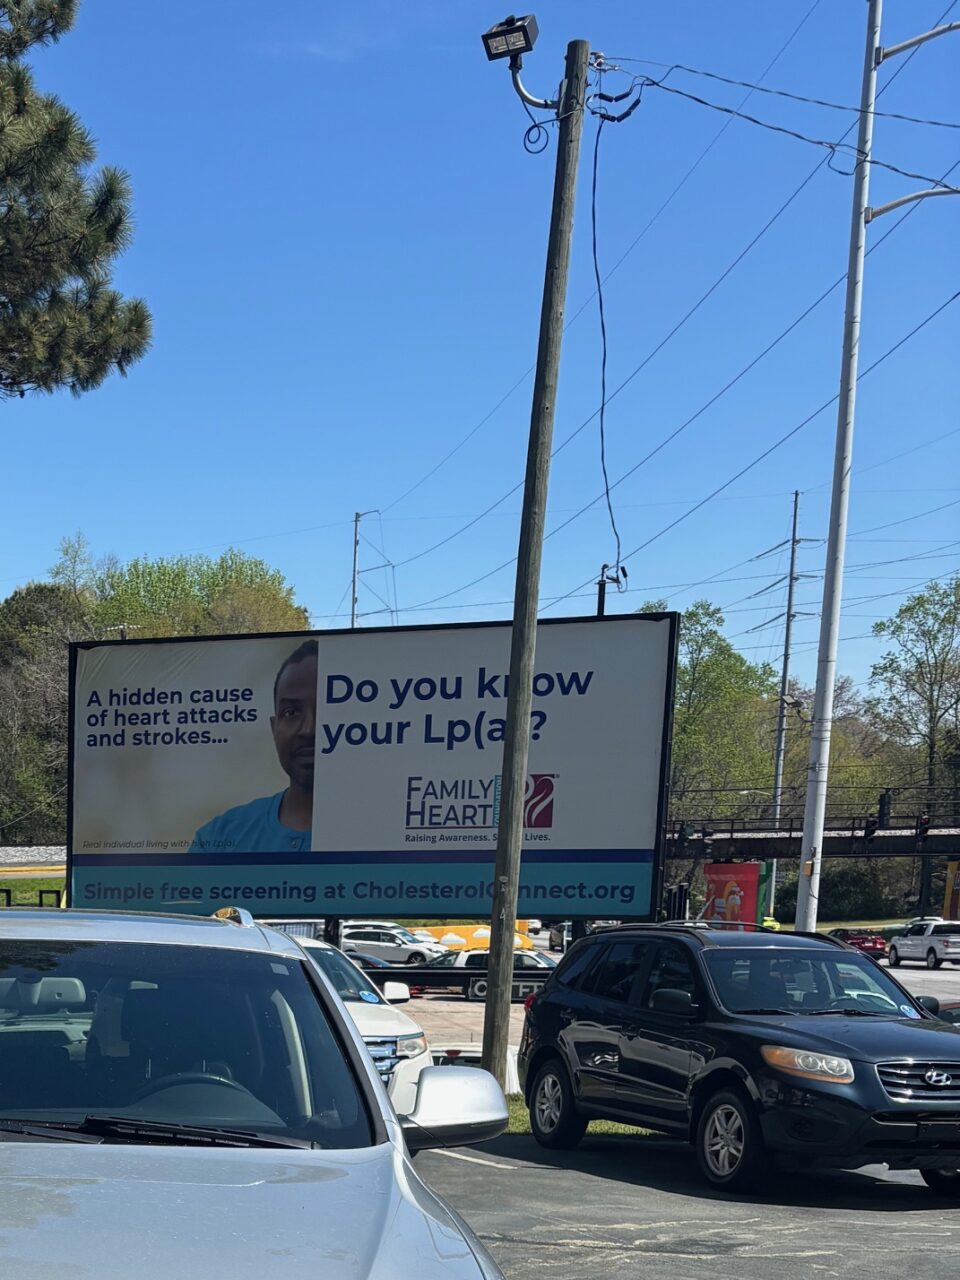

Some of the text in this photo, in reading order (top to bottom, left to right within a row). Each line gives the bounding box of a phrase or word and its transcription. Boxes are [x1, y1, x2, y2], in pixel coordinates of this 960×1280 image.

[86, 686, 253, 707] A hidden cause
[326, 674, 378, 704] Do
[389, 676, 462, 709] you
[86, 705, 258, 727] of heart attacks
[86, 725, 228, 747] and strokes...
[321, 711, 547, 754] your Lp(a?
[407, 776, 494, 800] FAMILY
[405, 800, 493, 826] HEART
[103, 839, 144, 849] individual
[146, 838, 169, 850] living
[170, 838, 189, 848] with
[405, 833, 437, 843] Raising
[438, 833, 491, 842] Awareness.
[524, 832, 551, 841] Lives.
[84, 883, 154, 903] Simple
[160, 882, 203, 900] free
[209, 881, 316, 902] screening
[324, 883, 345, 898] at
